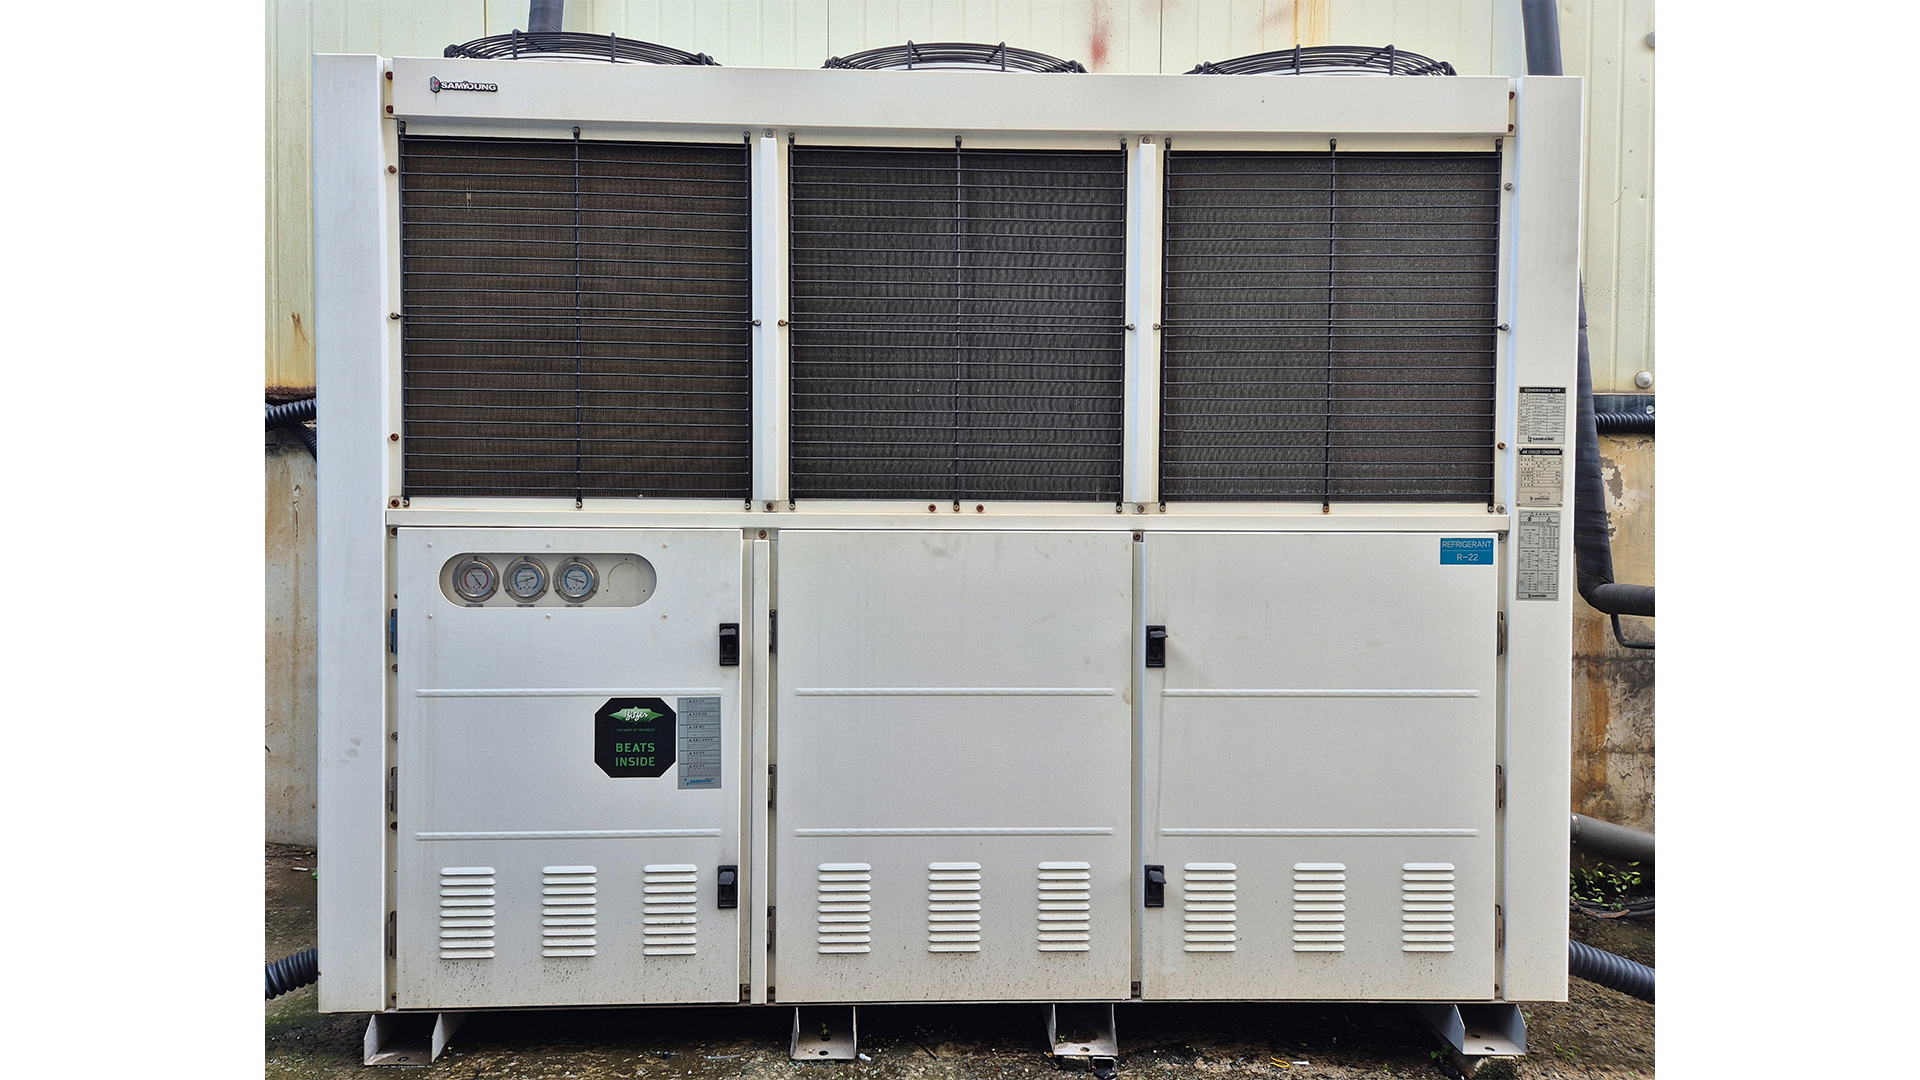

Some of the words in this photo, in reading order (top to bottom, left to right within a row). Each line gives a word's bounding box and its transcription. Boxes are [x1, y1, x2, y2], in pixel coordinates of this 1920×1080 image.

[441, 81, 497, 91] SAMYOUNG
[1441, 540, 1492, 548] REFRIGERANT
[1456, 553, 1479, 562] R-22
[615, 742, 655, 753] BEATS
[615, 756, 655, 767] INSIDE
